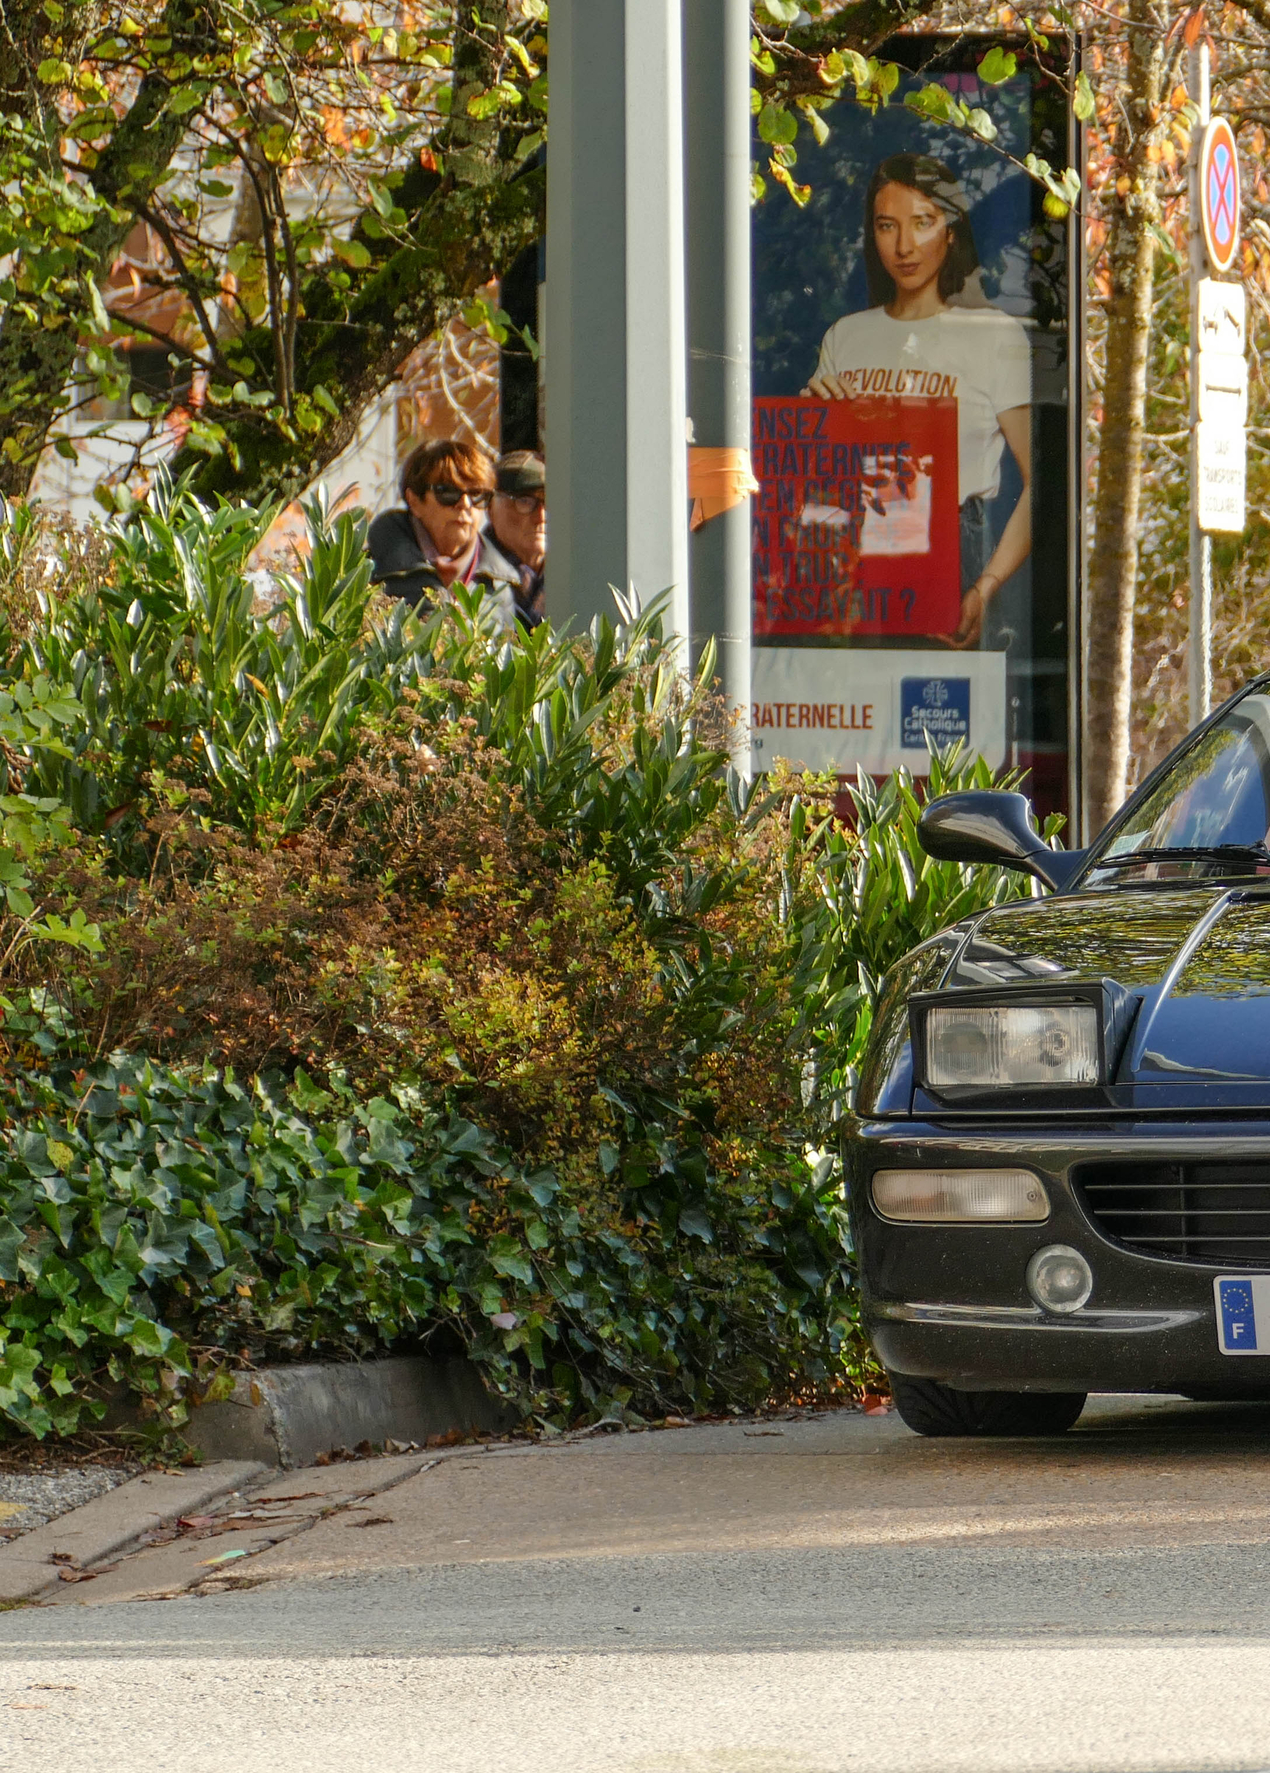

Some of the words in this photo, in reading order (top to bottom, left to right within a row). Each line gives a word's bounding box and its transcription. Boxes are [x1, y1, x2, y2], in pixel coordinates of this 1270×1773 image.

[779, 552, 849, 585] TRUC
[767, 587, 892, 622] ESSAYAIT
[901, 588, 917, 622] ?
[911, 705, 959, 719] Secours
[904, 716, 967, 732] Catholique
[1231, 1322, 1244, 1339] F
